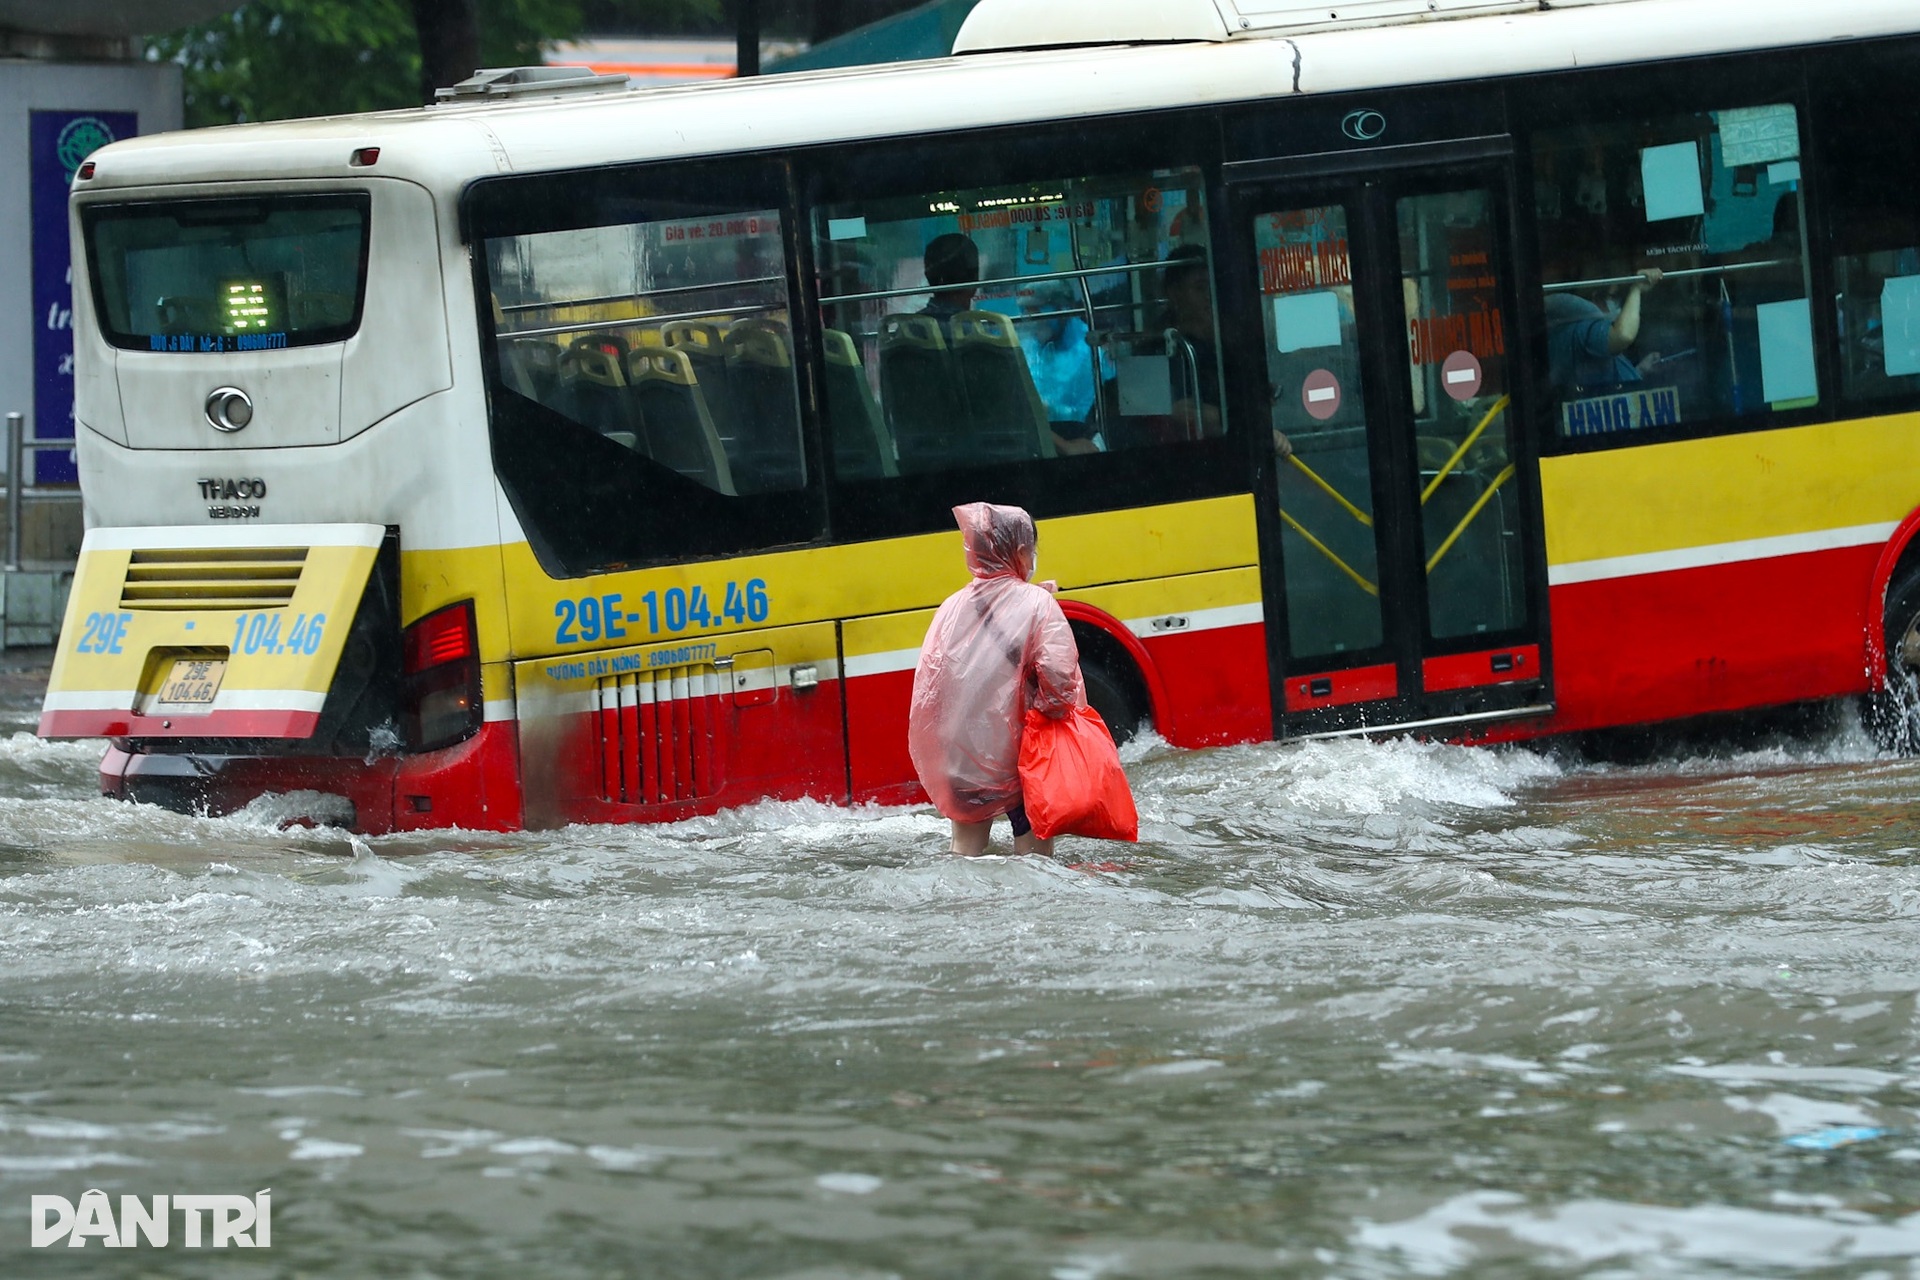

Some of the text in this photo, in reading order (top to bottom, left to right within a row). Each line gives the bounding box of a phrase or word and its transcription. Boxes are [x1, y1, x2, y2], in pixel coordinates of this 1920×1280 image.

[197, 477, 266, 500] THACO
[207, 505, 260, 518] MEADOW
[555, 578, 769, 645] 29E-104.46
[77, 612, 133, 654] 29E
[231, 613, 326, 655] 104.46
[183, 661, 212, 680] 29E
[168, 682, 212, 701] 104.46
